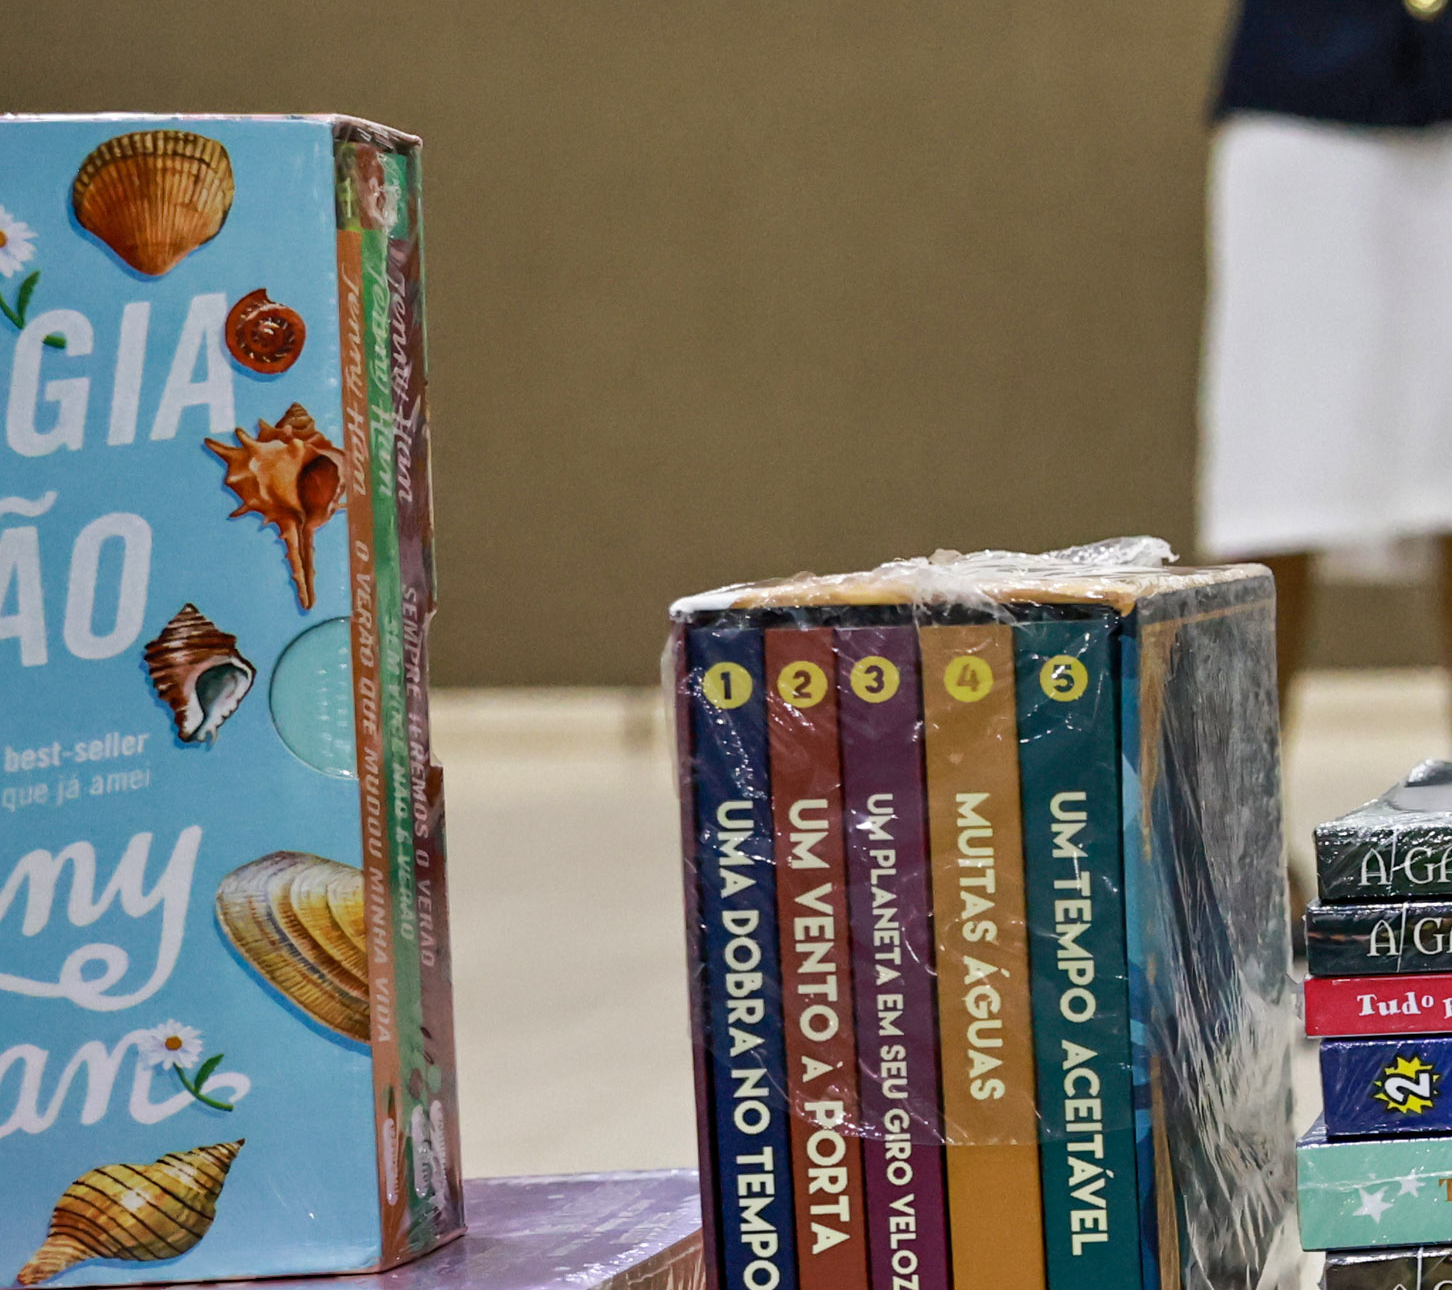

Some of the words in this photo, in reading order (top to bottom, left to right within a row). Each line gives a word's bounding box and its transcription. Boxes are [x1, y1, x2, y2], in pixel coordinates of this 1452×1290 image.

[4, 730, 149, 771] best-seller
[716, 800, 754, 897] UMA
[789, 798, 828, 869] UM
[866, 793, 896, 843] UM
[1049, 791, 1087, 858] UM
[956, 792, 998, 944] MUITAS
[1359, 848, 1390, 886] A
[869, 848, 900, 986] PLANETA
[1053, 873, 1097, 1024] TEMPO
[1367, 919, 1399, 957] A
[722, 910, 764, 1057] DOBRA
[795, 883, 838, 1042] VENTO
[877, 995, 903, 1035] EM
[963, 954, 1006, 1102] ÁGUAS
[1358, 993, 1435, 1017] Tudo
[731, 1066, 769, 1135] NO
[800, 1057, 826, 1083] À
[880, 1045, 908, 1113] SEU
[804, 1100, 850, 1255] PORTA
[883, 1111, 914, 1186] GIRO
[1061, 1040, 1108, 1255] ACEITÁVEL
